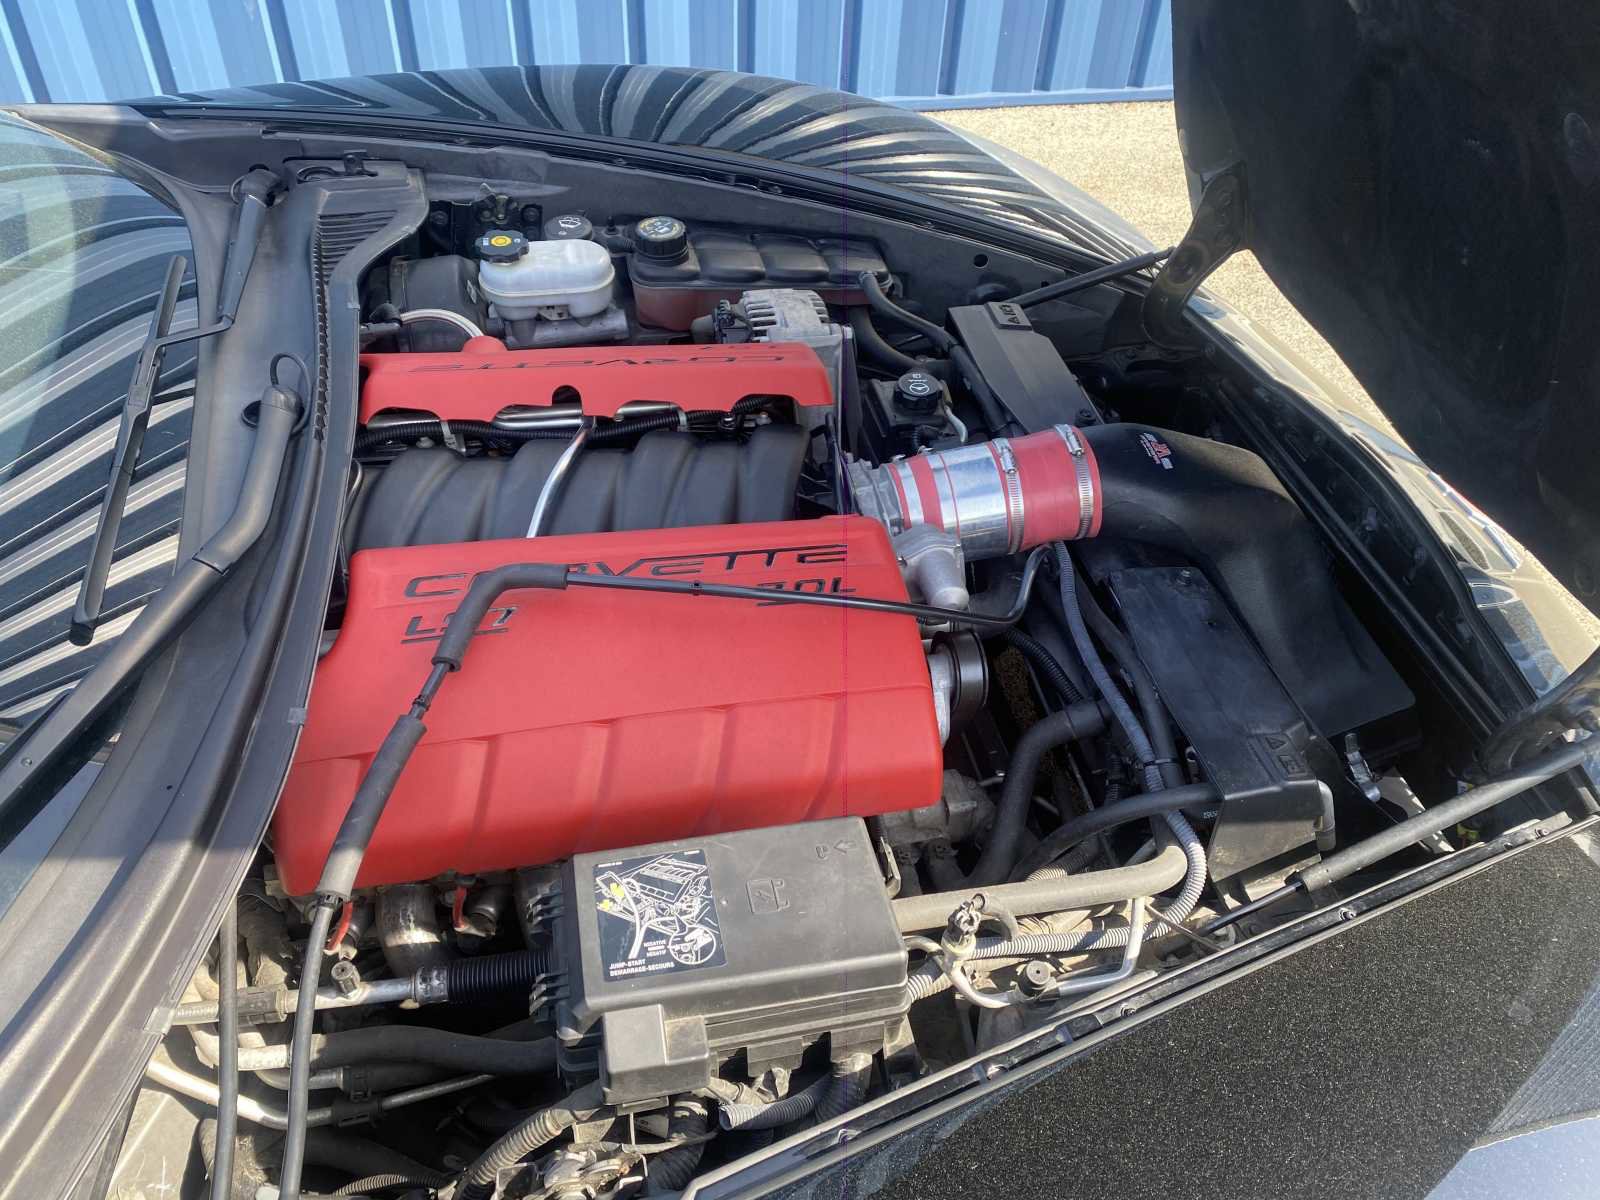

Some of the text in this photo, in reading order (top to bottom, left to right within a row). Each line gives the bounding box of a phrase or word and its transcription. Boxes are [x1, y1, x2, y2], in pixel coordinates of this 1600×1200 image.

[404, 544, 848, 598] CVETTE
[757, 576, 857, 599] 70L
[404, 605, 518, 636] L7
[609, 958, 646, 970] JUMP-START
